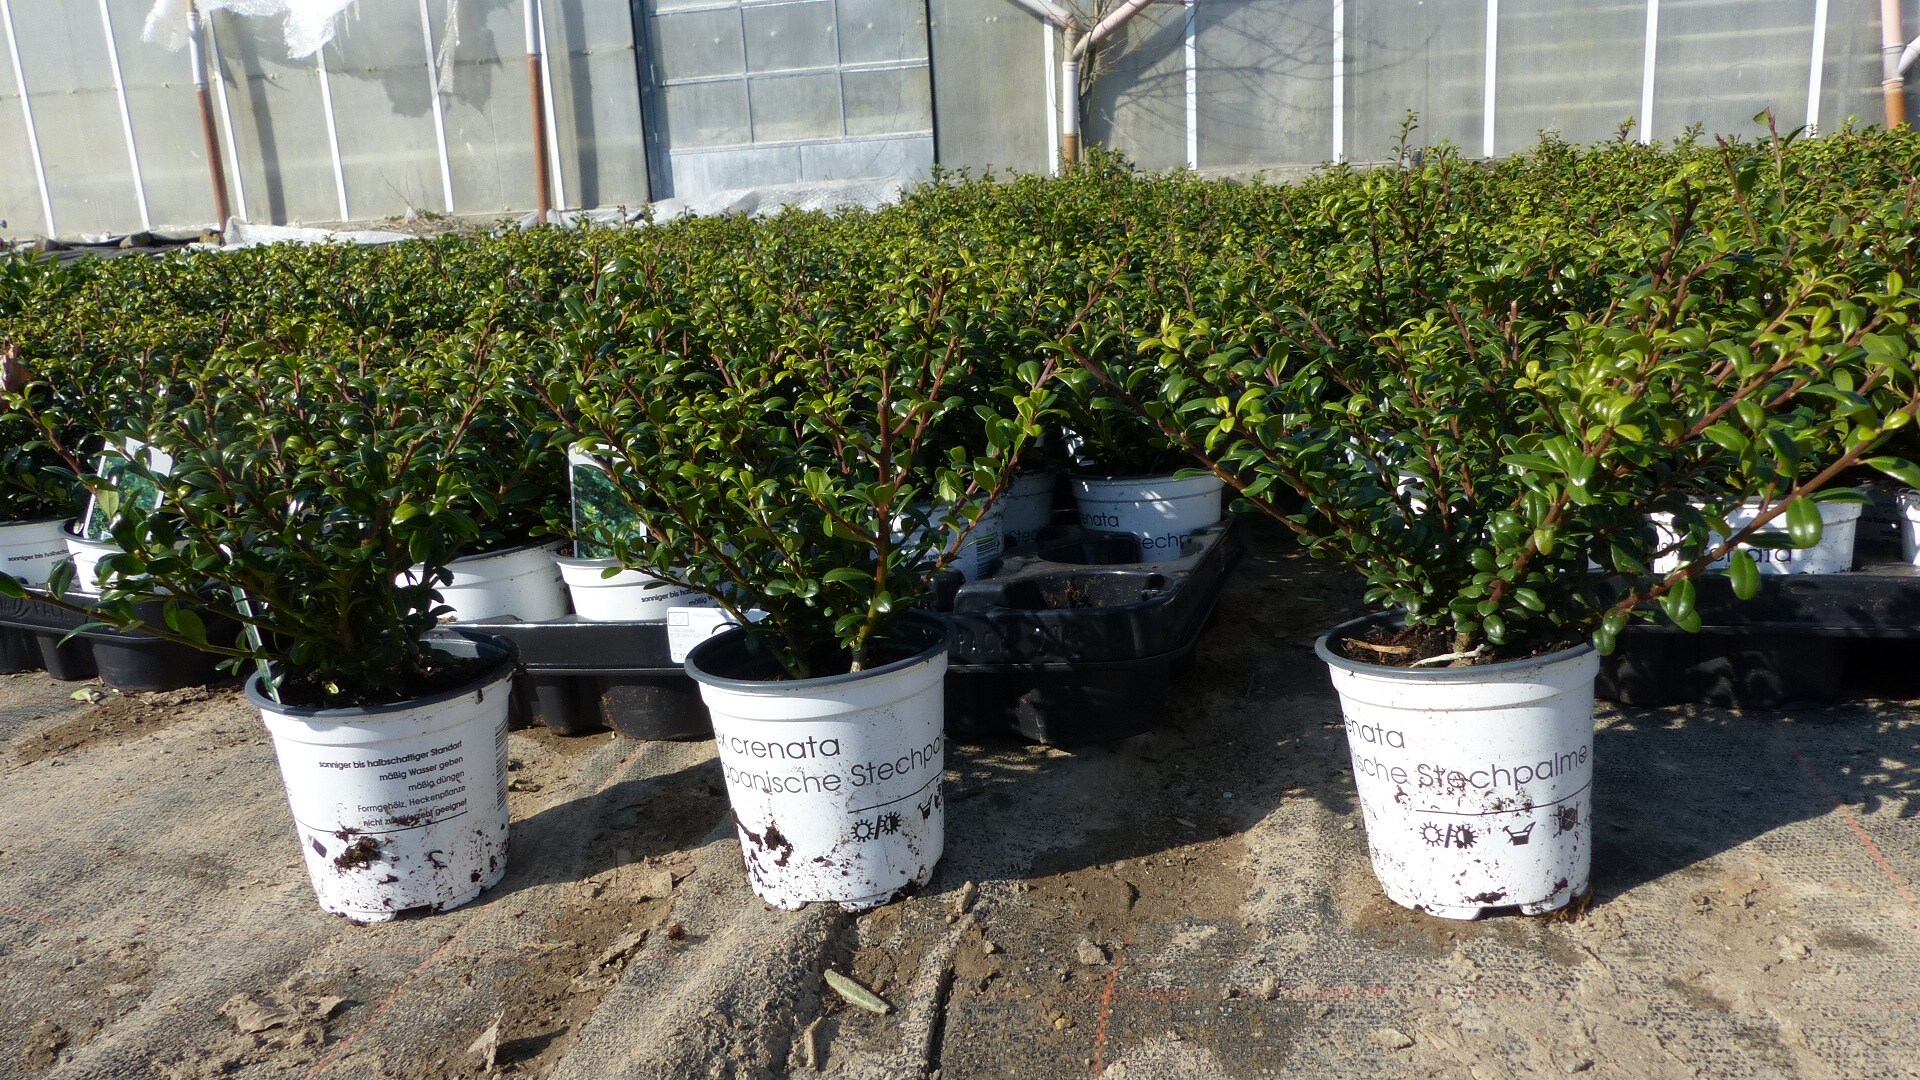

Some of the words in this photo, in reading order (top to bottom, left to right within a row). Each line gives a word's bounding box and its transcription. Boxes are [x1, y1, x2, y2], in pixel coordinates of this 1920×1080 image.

[641, 593, 669, 603] sonniger
[669, 590, 680, 599] bis
[318, 760, 351, 771] sonniger
[353, 760, 366, 769] bis
[367, 751, 429, 769] halbschattiger
[430, 740, 463, 757] Standort
[731, 735, 841, 759] crenata
[851, 727, 943, 788] Stechpa
[379, 769, 407, 782] mäßig
[408, 765, 437, 777] Wasser
[439, 755, 464, 770] geben
[408, 779, 435, 793] mäßig
[436, 770, 465, 785] düngen
[1417, 745, 1588, 790] Stechpalme
[357, 800, 408, 814] Formgehölz,
[409, 784, 466, 807] Heckenpflanze
[363, 814, 384, 827] nicht
[435, 798, 468, 816] geeignet
